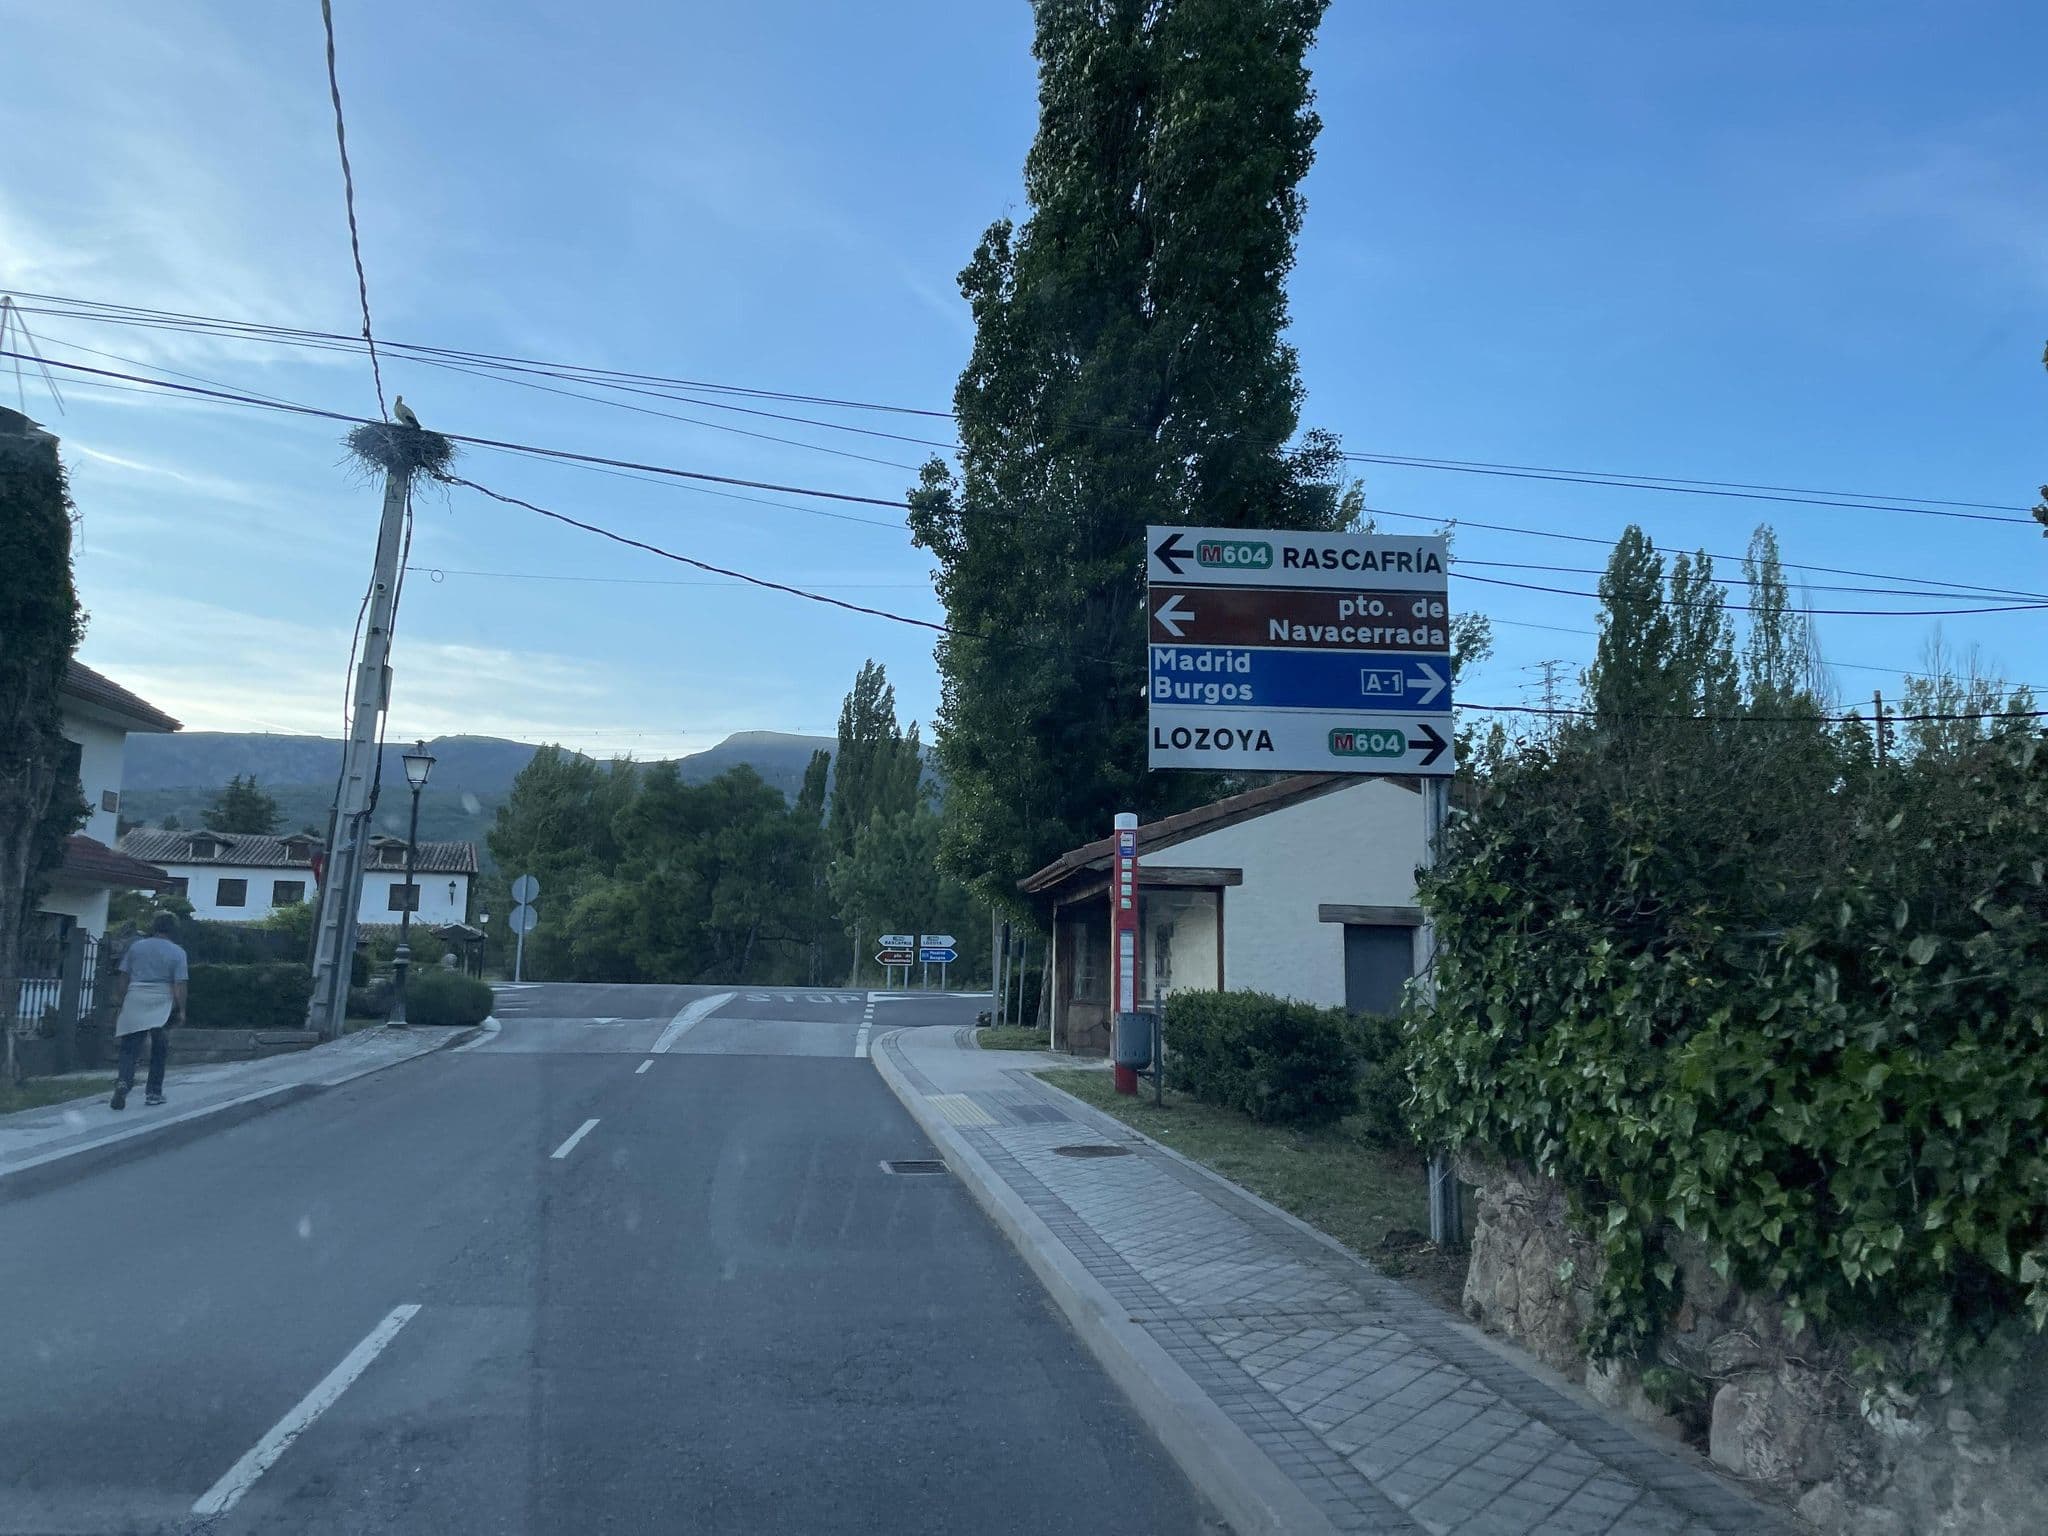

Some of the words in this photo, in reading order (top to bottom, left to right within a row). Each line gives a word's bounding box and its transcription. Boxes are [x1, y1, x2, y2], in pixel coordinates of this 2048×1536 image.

[1201, 544, 1269, 563] M604
[1283, 547, 1442, 573] RASCAFRÍA
[1339, 596, 1393, 620] pto.
[1412, 598, 1445, 618] de
[1269, 619, 1445, 645] Navacerrada
[1154, 649, 1251, 673] Madrid
[1154, 677, 1254, 704] Burgos
[1366, 673, 1401, 692] A-1
[1154, 727, 1274, 752] LOZOYA
[1334, 733, 1401, 752] M604
